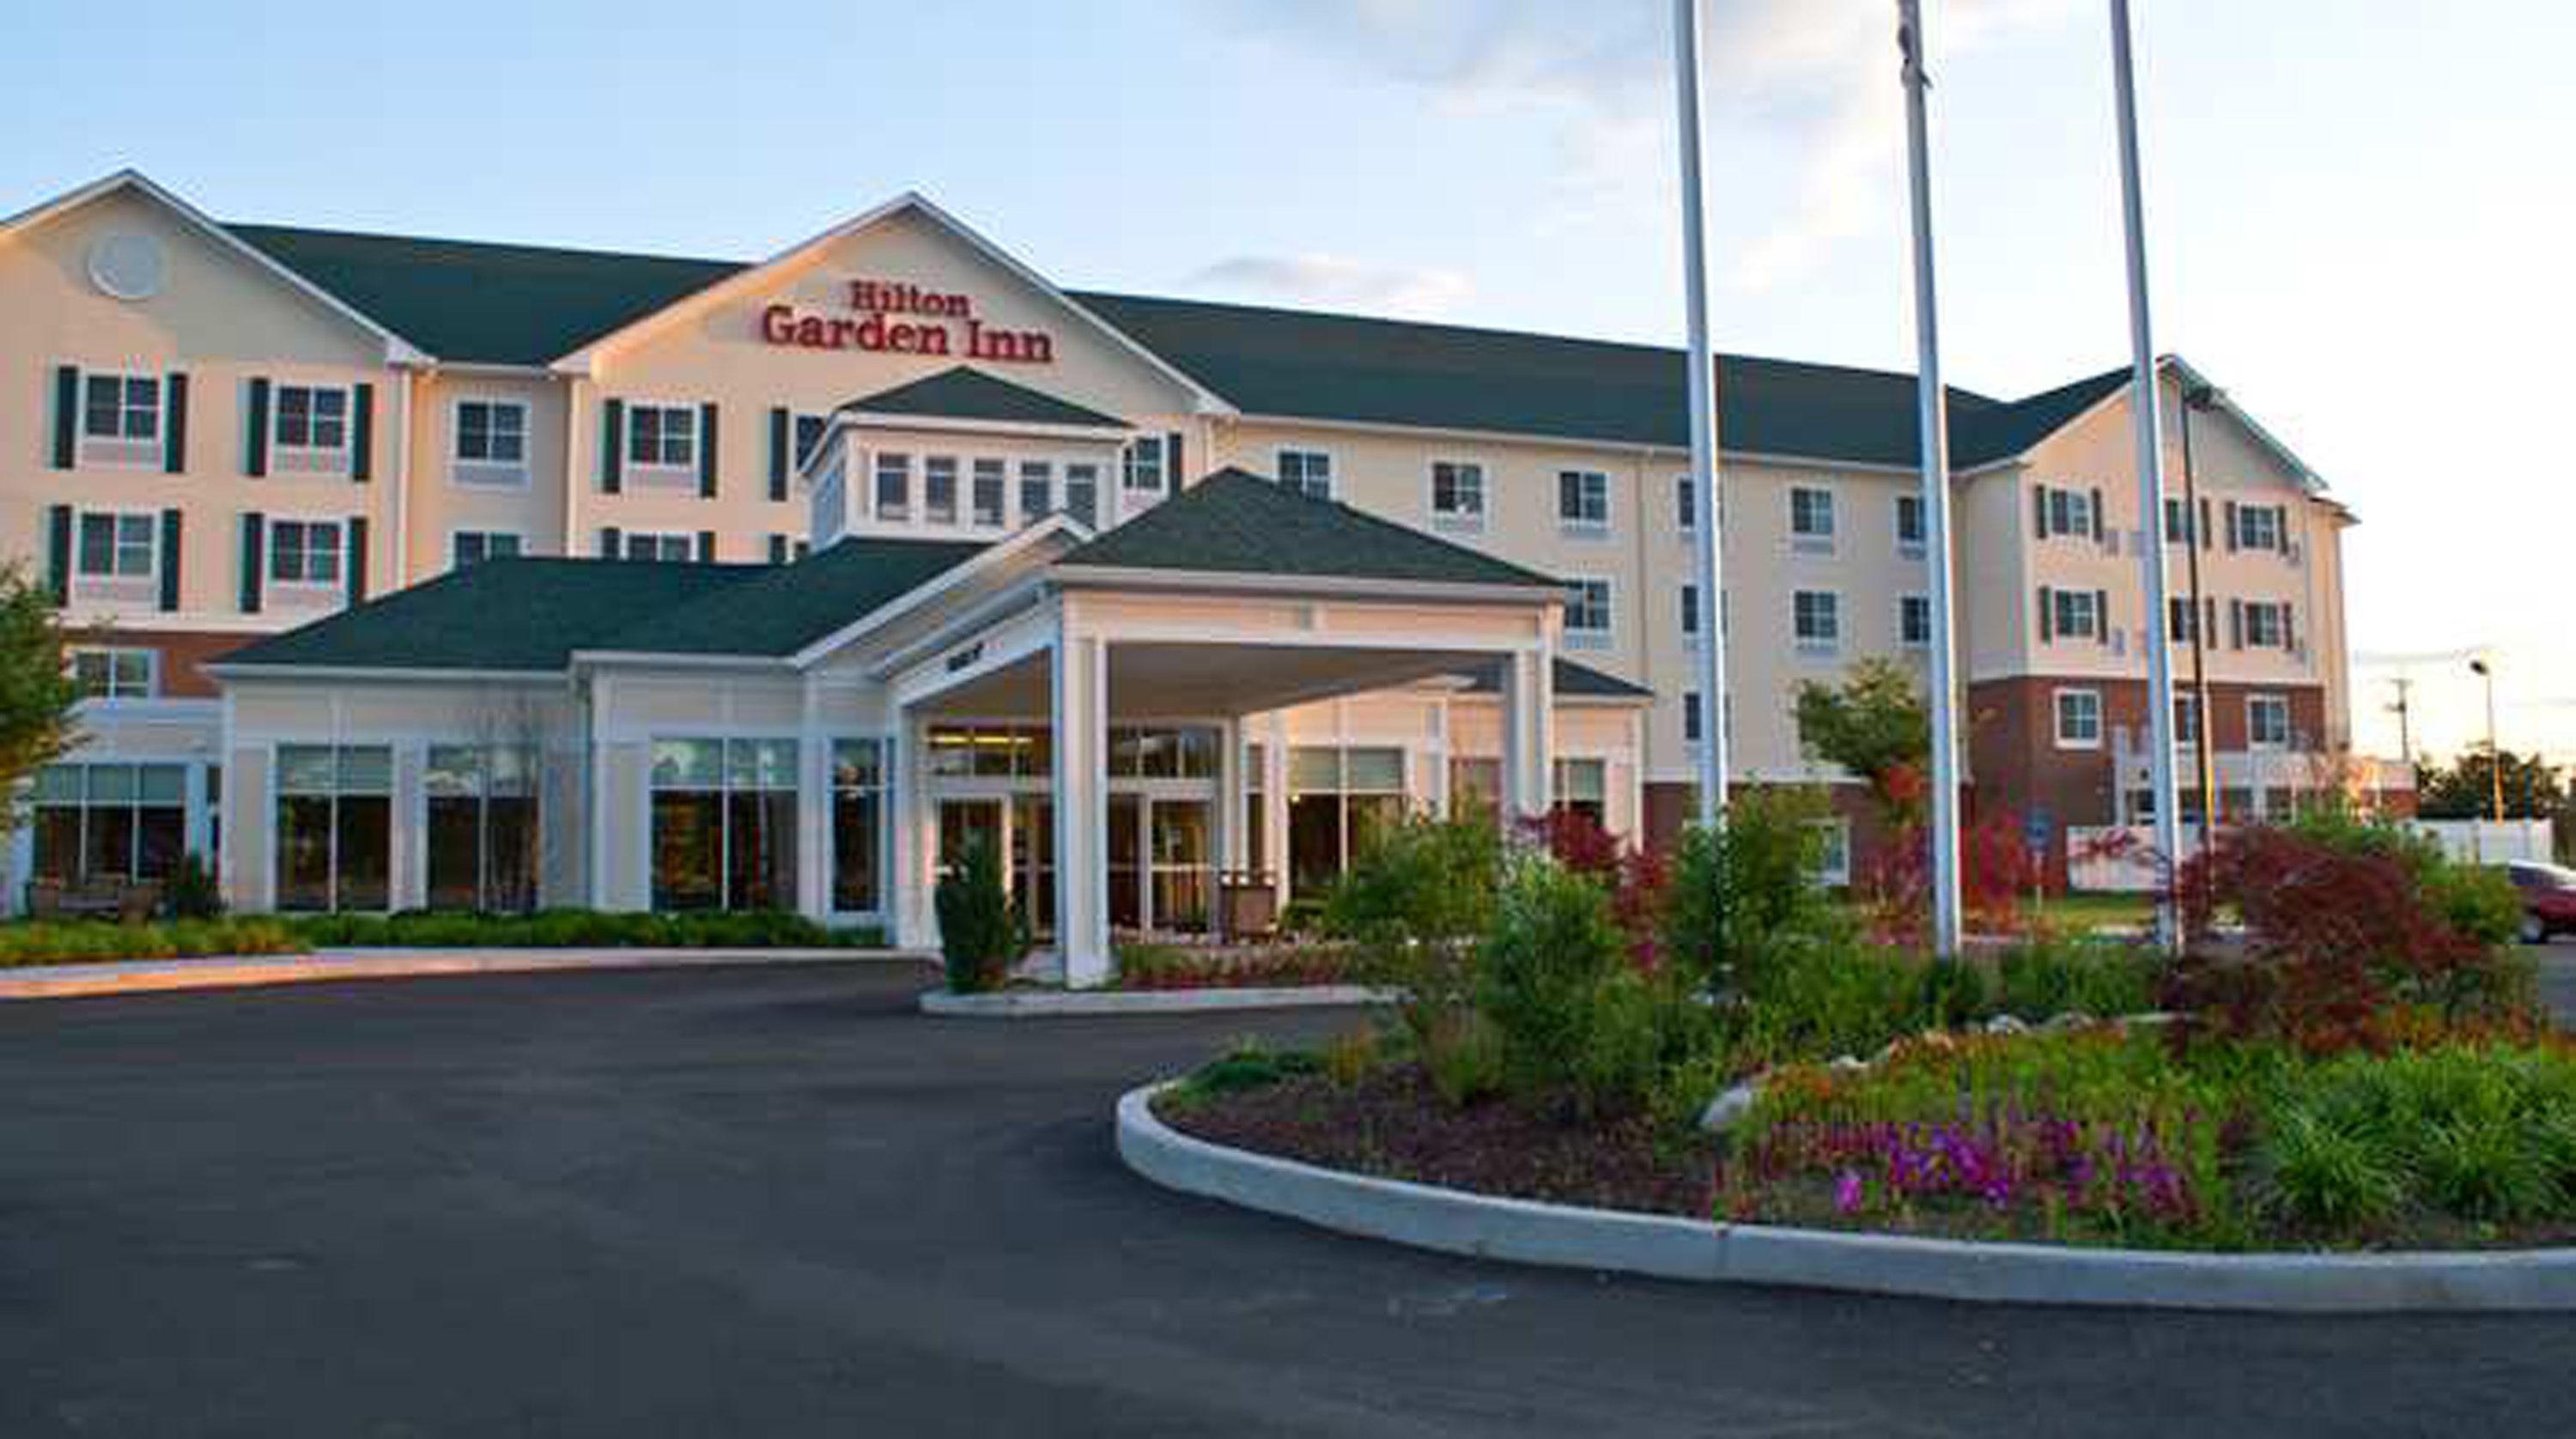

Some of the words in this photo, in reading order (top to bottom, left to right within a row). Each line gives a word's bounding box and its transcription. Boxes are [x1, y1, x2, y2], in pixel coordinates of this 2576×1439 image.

[850, 280, 970, 317] Hilton
[762, 305, 949, 355] Garden
[969, 320, 1053, 363] Inn
